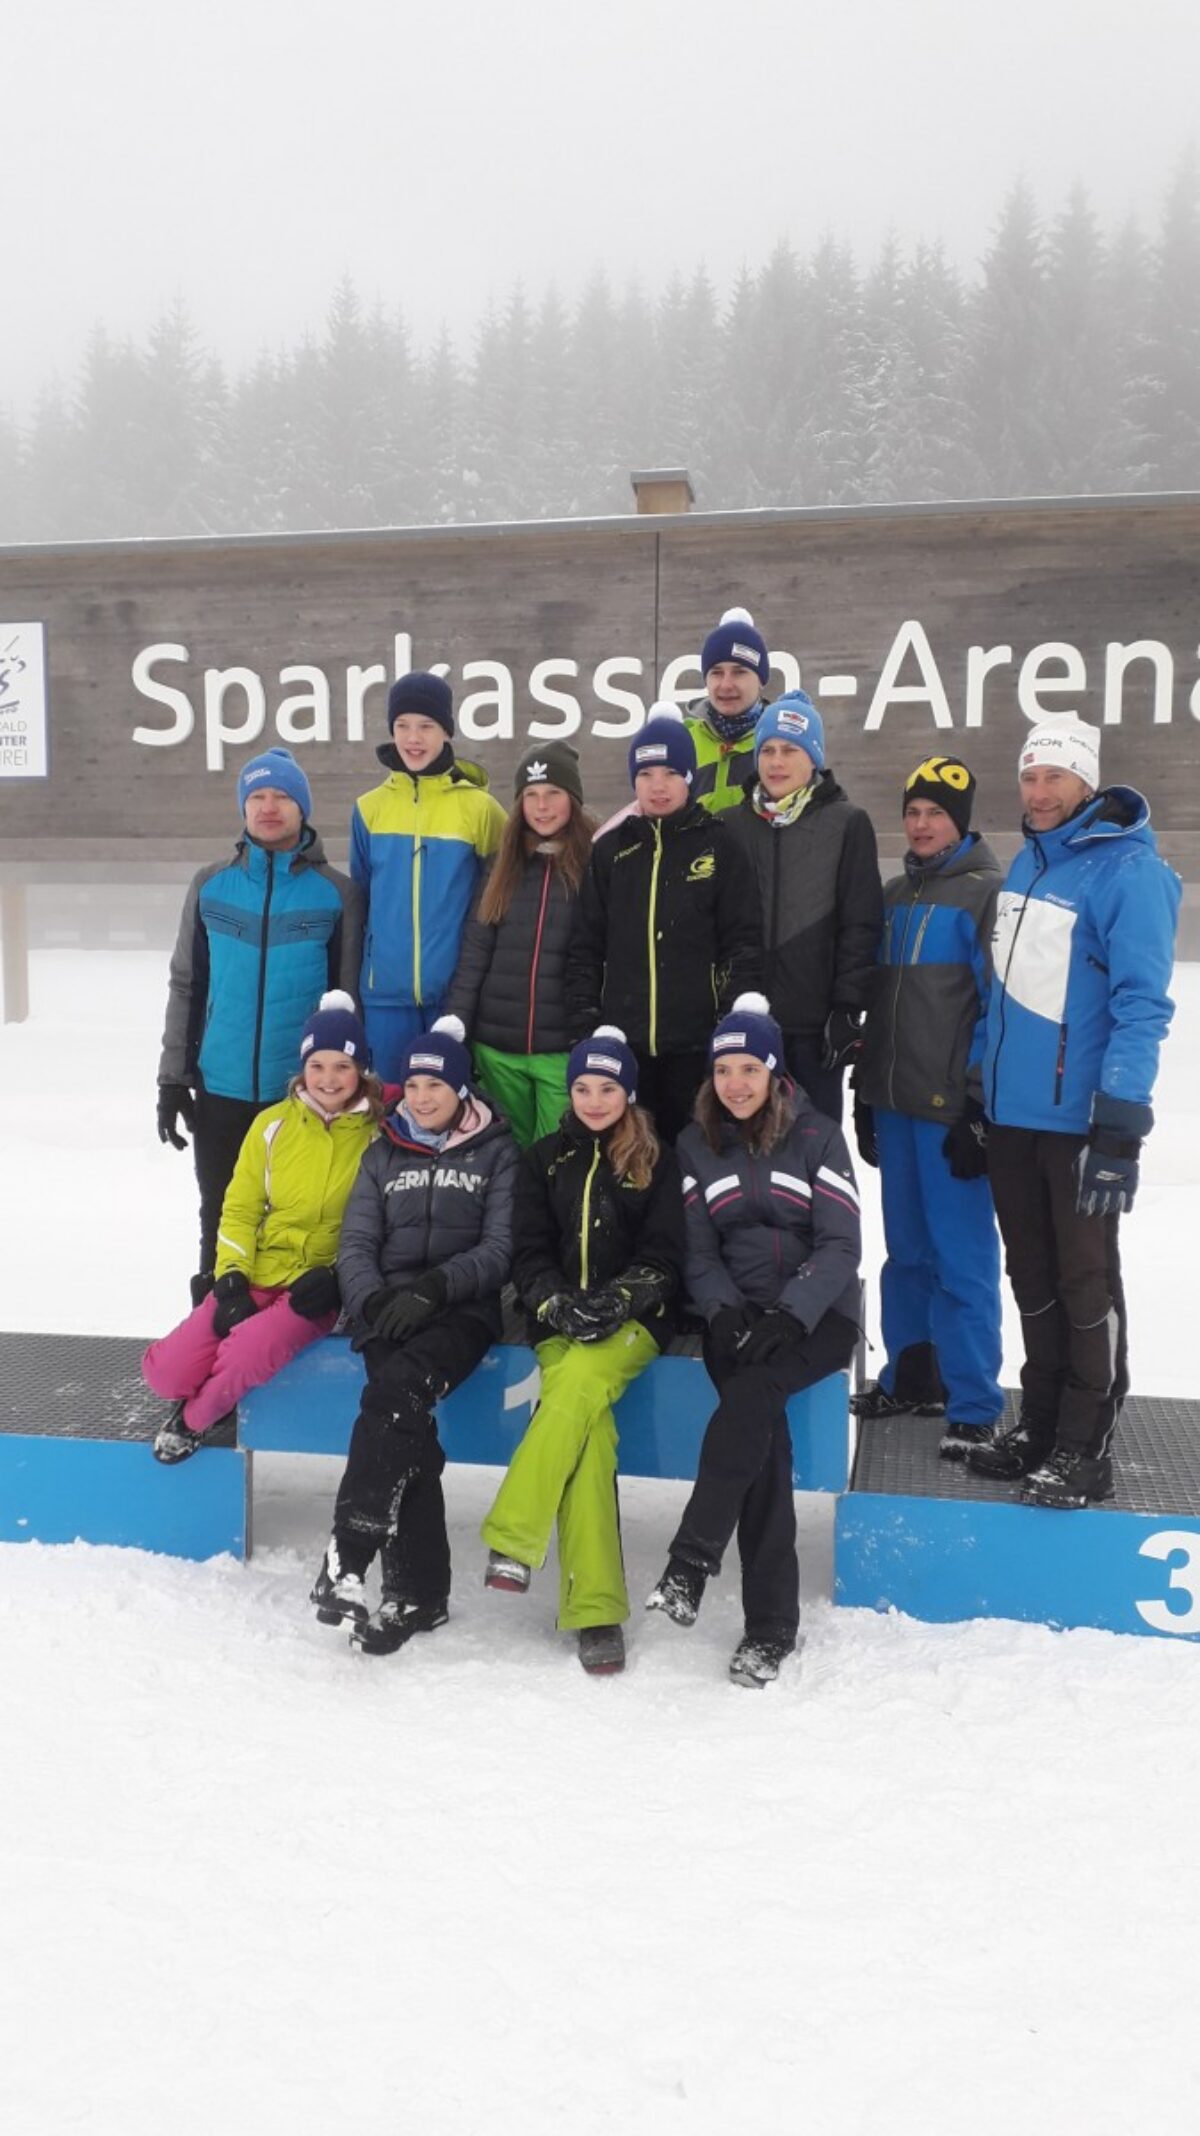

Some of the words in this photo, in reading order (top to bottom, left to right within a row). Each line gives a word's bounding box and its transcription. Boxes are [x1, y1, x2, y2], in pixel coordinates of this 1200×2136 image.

[0, 720, 28, 732] ALD
[131, 620, 1200, 771] Sparassen-Aren
[1135, 1530, 1200, 1634] 3
